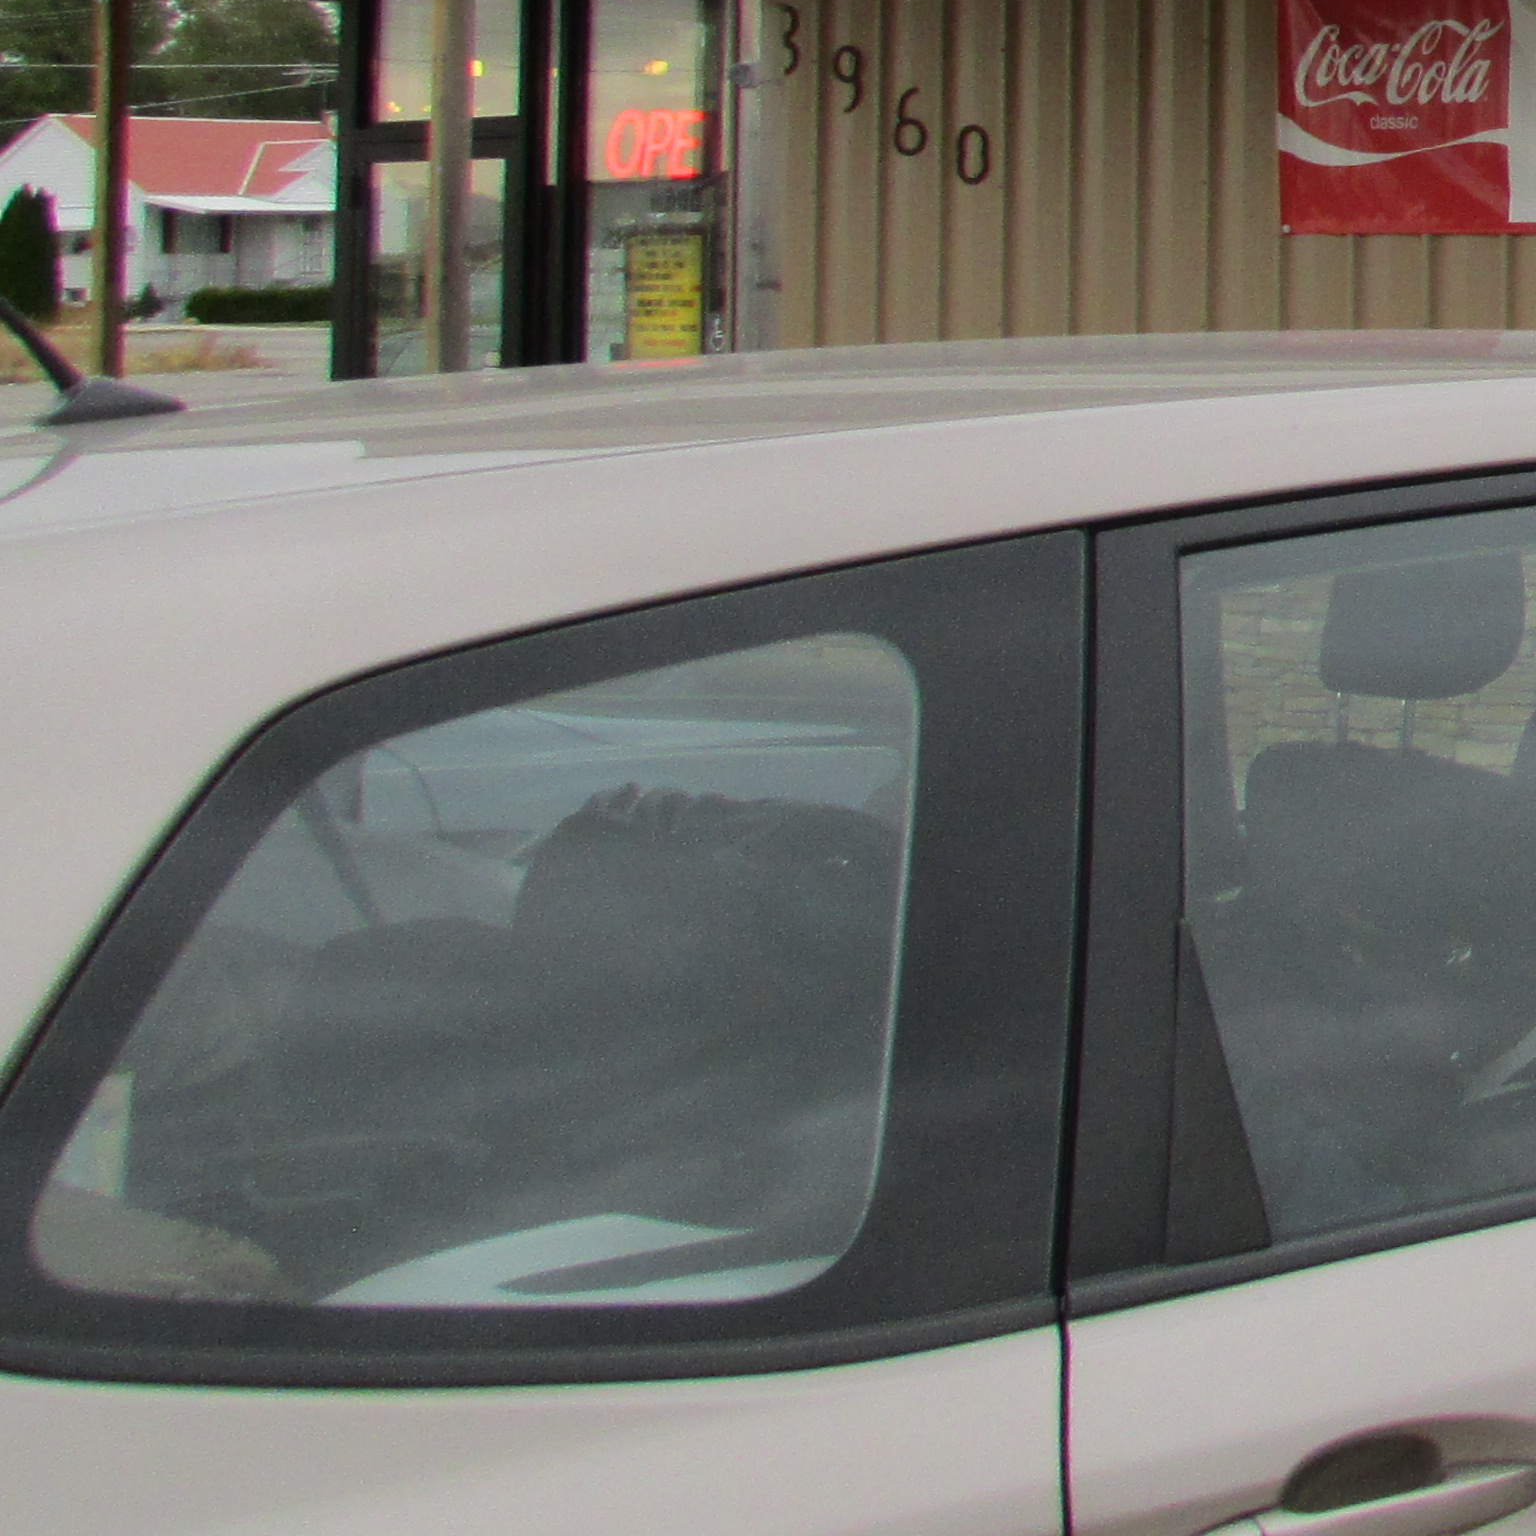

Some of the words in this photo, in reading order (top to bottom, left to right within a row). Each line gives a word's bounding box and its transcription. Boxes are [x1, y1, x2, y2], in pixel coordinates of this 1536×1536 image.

[1294, 17, 1504, 107] Coca-Cola
[604, 107, 705, 181] OPE
[1369, 114, 1420, 131] classic
